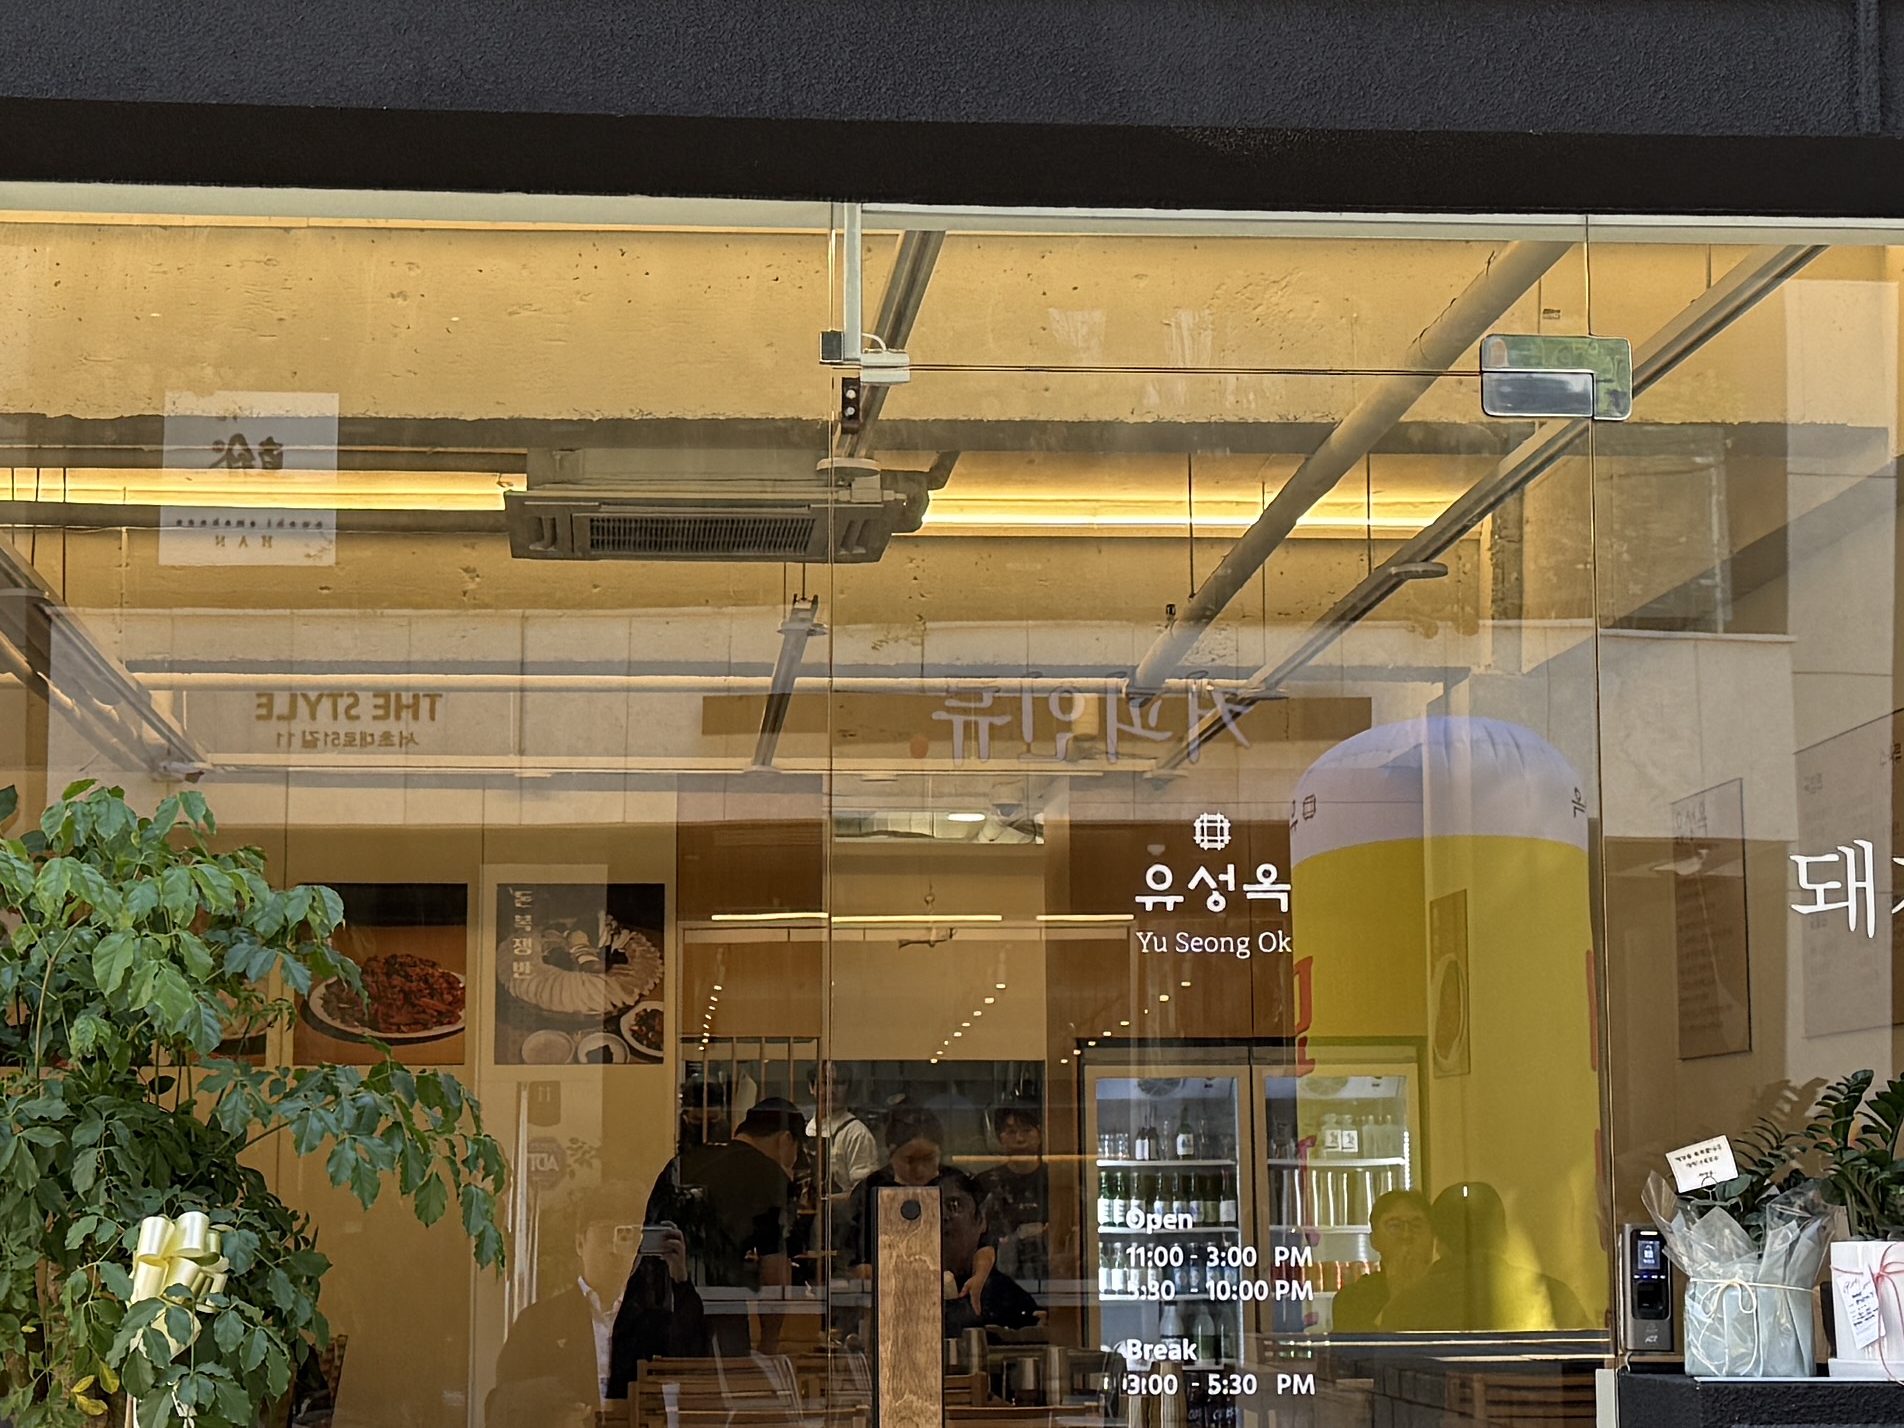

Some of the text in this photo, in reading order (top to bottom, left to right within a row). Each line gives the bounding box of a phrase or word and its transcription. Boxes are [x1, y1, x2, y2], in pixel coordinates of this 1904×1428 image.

[1134, 863, 1292, 913] 유성옥
[1135, 929, 1292, 960] Yu Seong Ok
[1126, 1207, 1194, 1234] Open
[1126, 1246, 1184, 1268] 11:00
[1207, 1246, 1257, 1268] 3:00
[1274, 1246, 1313, 1268] PM
[1207, 1280, 1269, 1302] 10:00
[1275, 1280, 1314, 1302] PM
[1127, 1338, 1198, 1361] Break
[1127, 1373, 1178, 1395] 3:00
[1208, 1373, 1258, 1395] 5:30
[1277, 1373, 1316, 1396] PM
